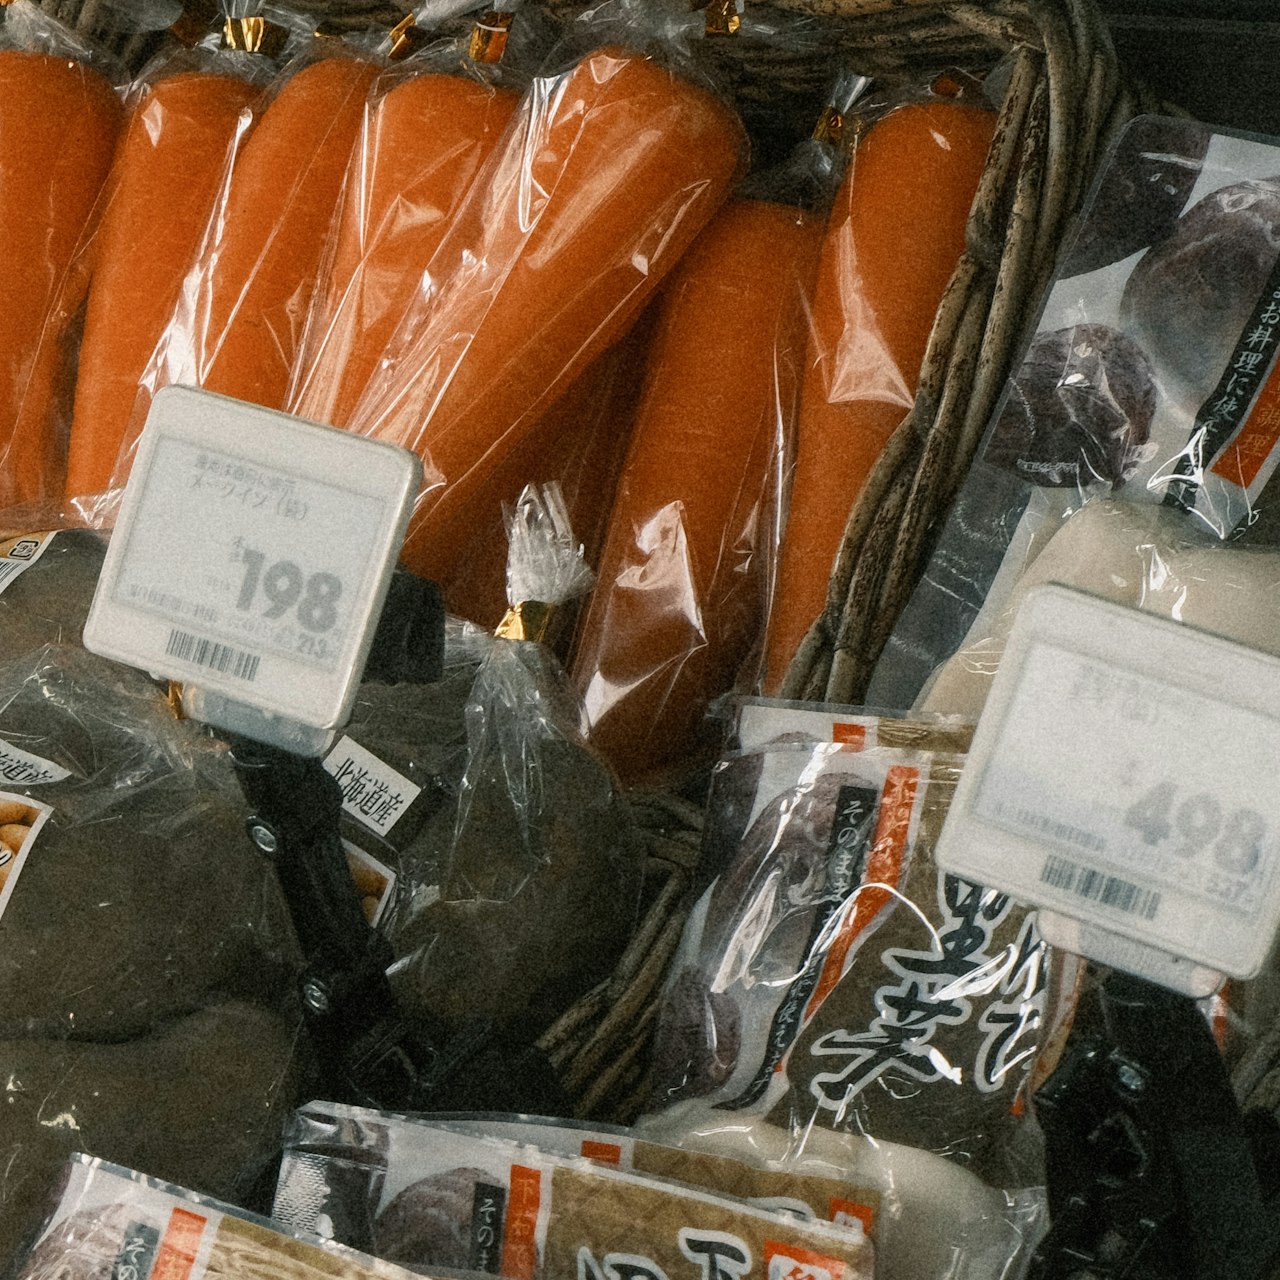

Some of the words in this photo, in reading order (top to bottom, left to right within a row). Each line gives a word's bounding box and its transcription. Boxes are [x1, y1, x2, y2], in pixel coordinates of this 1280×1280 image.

[235, 548, 343, 634] 198
[297, 632, 330, 660] 213
[333, 757, 405, 828] 北海道産
[1124, 780, 1269, 876] 498
